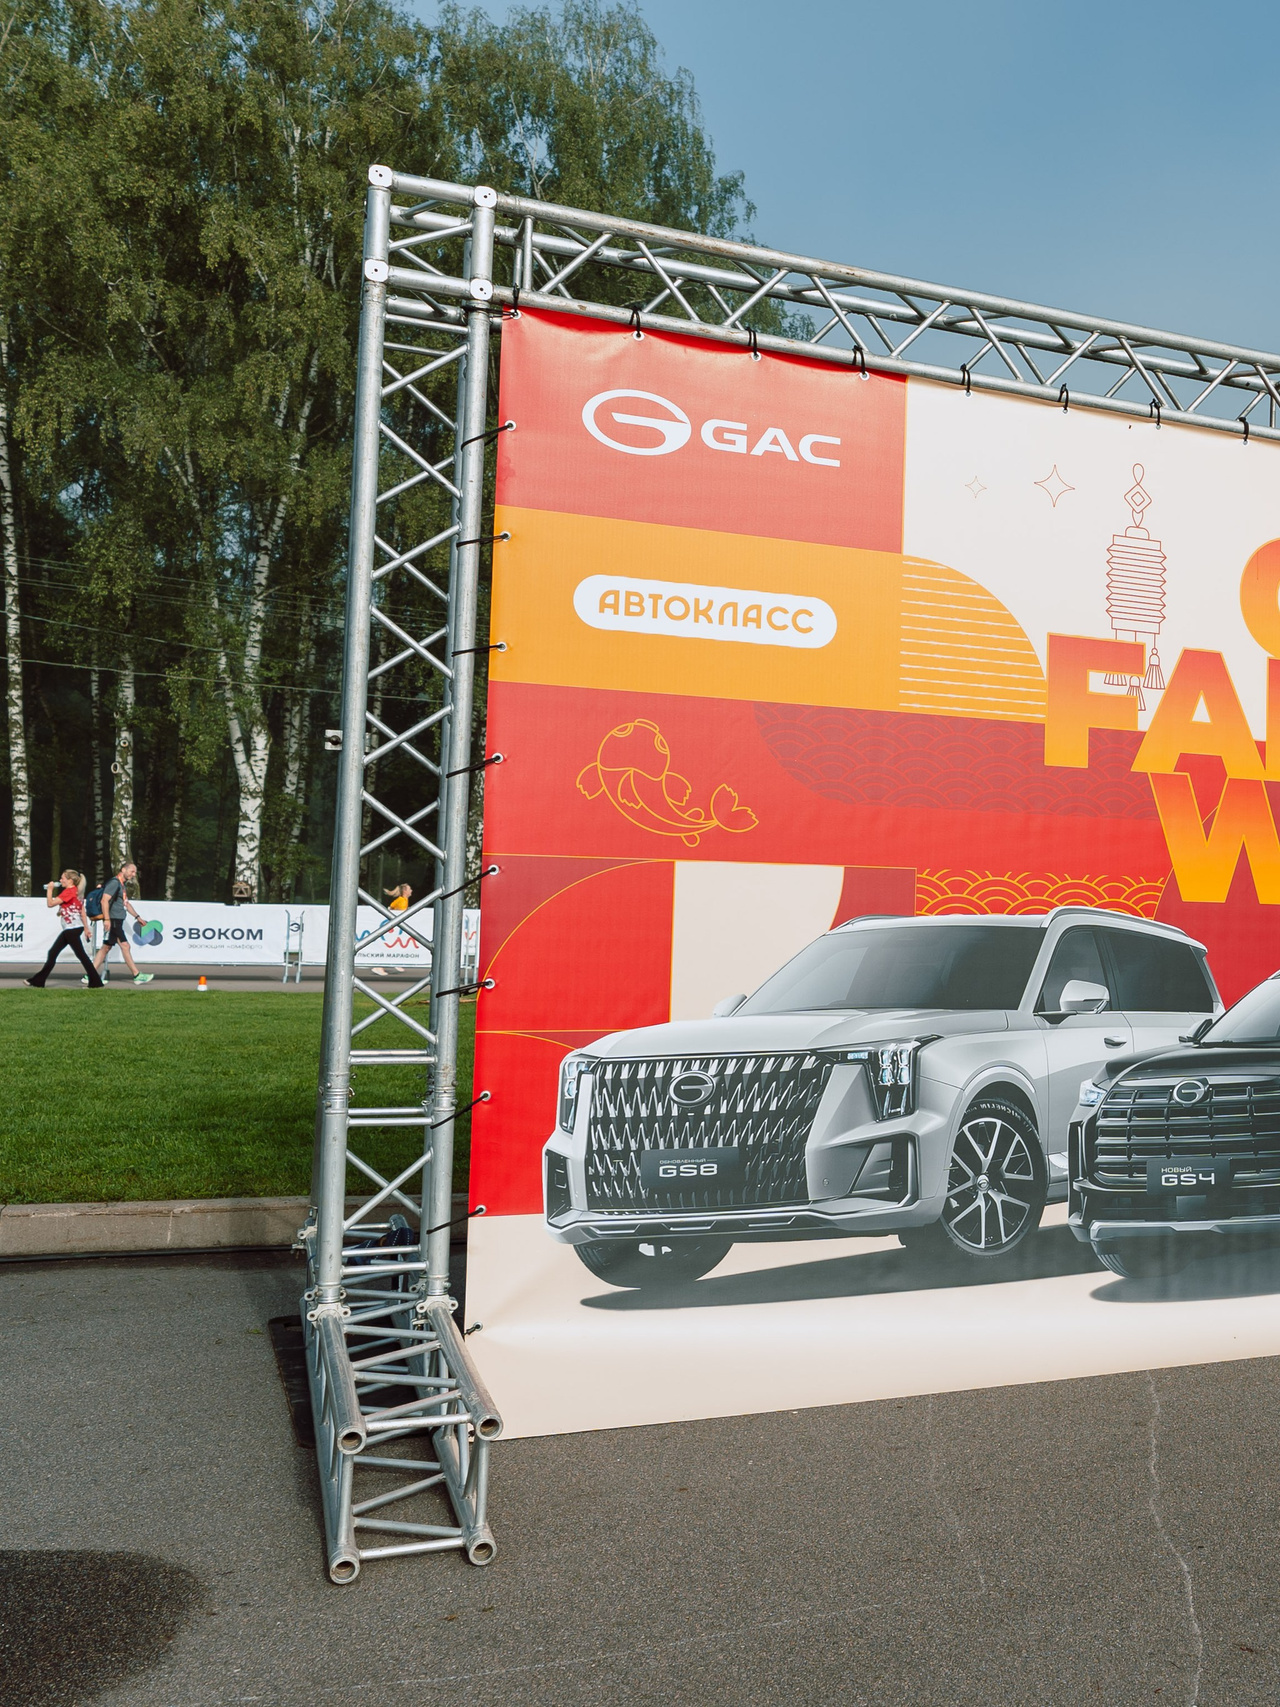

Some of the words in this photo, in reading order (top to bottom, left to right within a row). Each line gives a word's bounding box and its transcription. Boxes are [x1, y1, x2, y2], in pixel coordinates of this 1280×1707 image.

[700, 418, 841, 468] GAC
[598, 589, 815, 634] АВТОКЛАСС
[0, 912, 16, 921] РТ
[173, 927, 263, 941] ЭВОКОМ
[659, 1163, 718, 1178] GS8
[1161, 1172, 1215, 1186] GS4
